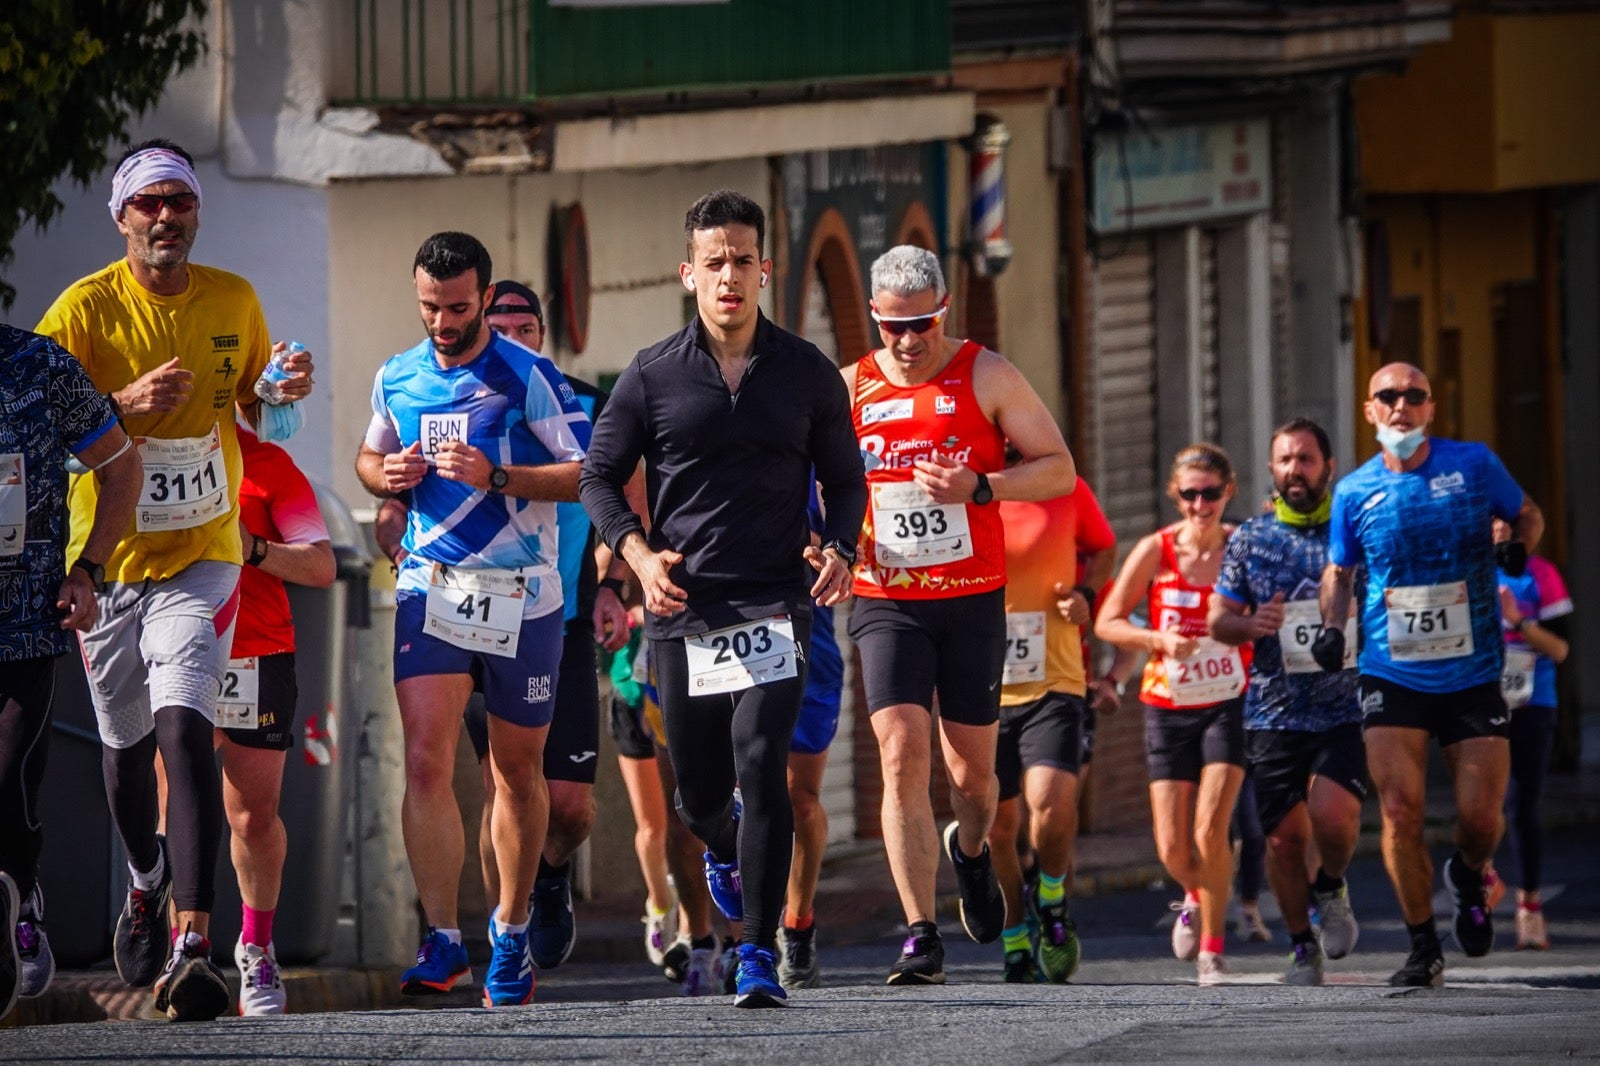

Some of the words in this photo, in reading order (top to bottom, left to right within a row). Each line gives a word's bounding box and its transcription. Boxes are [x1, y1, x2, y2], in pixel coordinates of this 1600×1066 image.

[429, 420, 461, 437] RUN
[890, 439, 934, 452] Clínicas
[150, 460, 217, 502] 3111
[894, 508, 948, 539] 393
[456, 594, 492, 622] 41
[1404, 608, 1450, 634] 751
[711, 625, 773, 666] 203
[1295, 624, 1325, 645] 67
[528, 674, 551, 688] RUN
[1177, 657, 1234, 684] 2108
